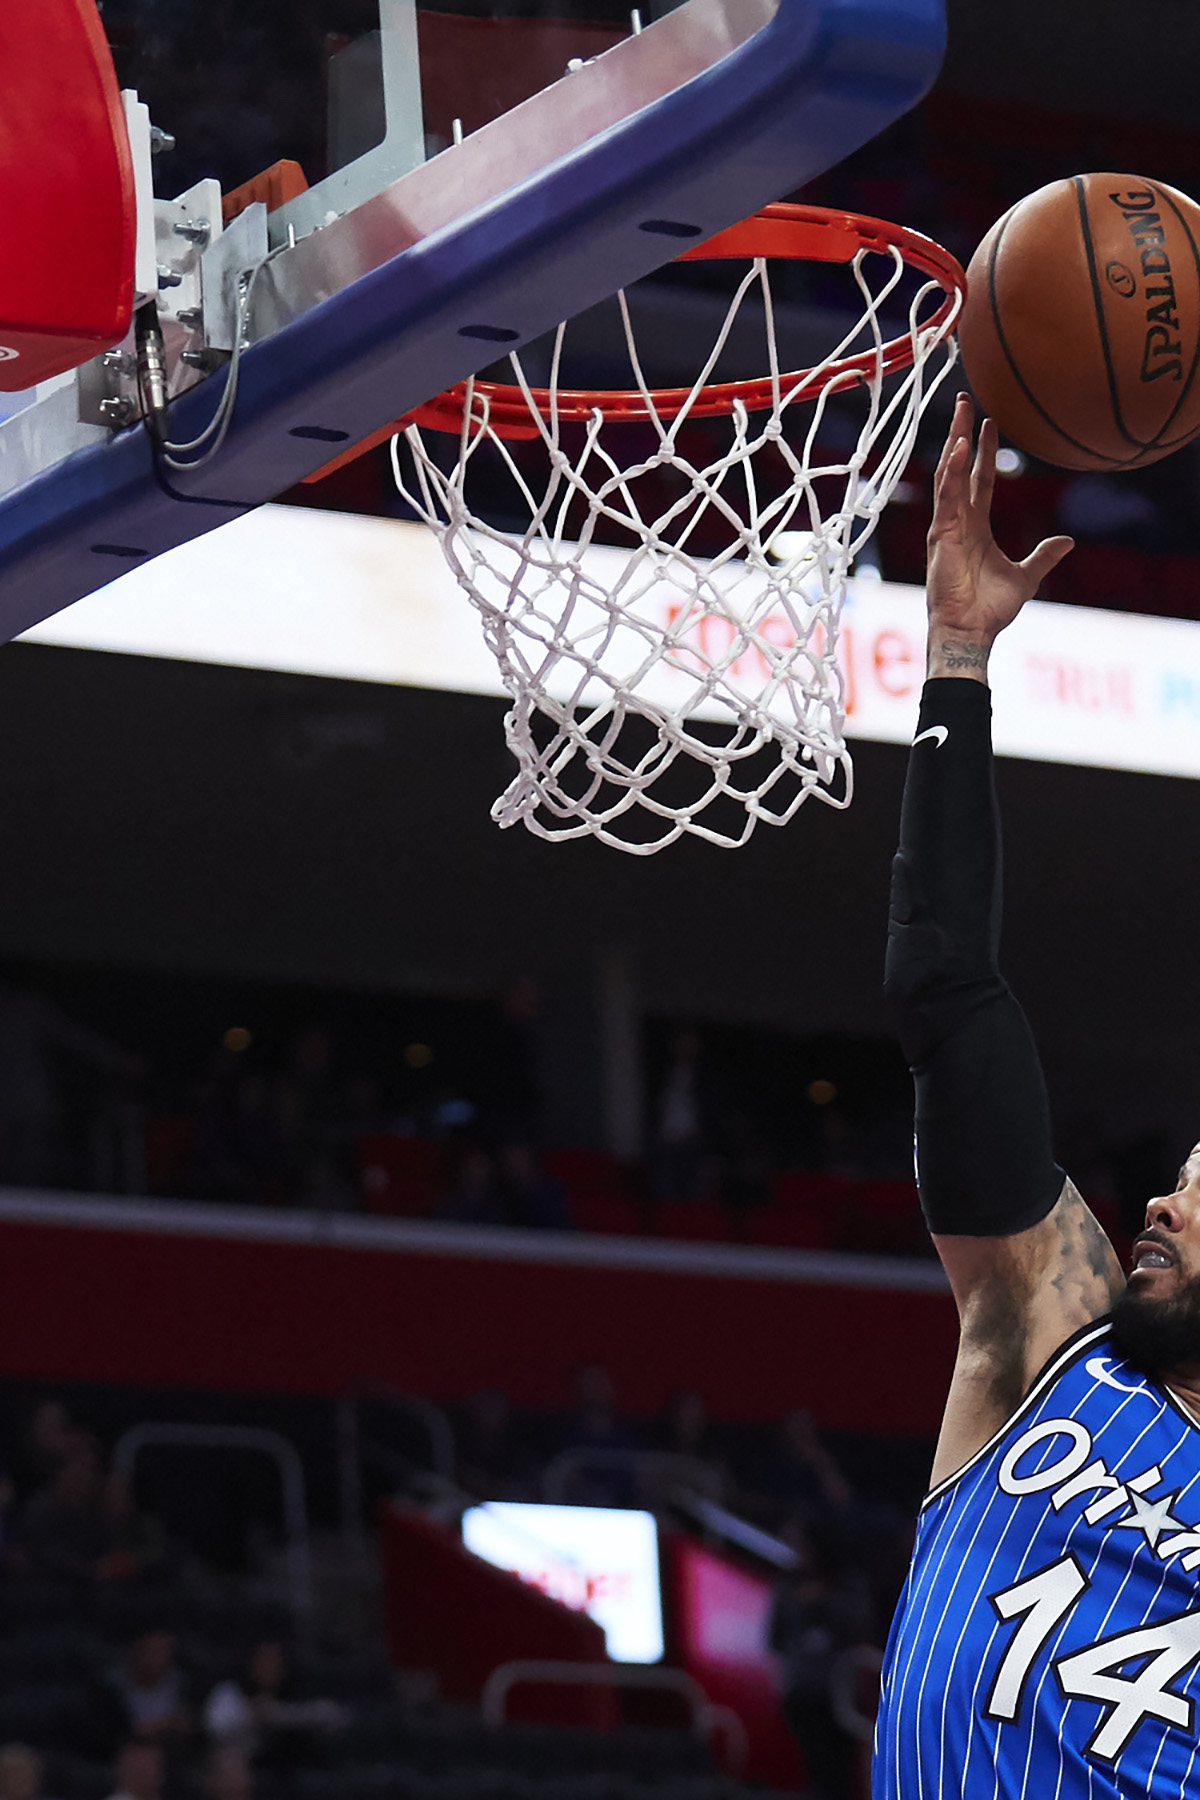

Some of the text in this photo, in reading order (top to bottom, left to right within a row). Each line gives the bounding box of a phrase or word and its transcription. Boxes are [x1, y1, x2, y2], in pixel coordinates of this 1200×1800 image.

[1108, 190, 1183, 384] SPALDING
[665, 590, 913, 715] meije
[1025, 651, 1136, 717] TRUE
